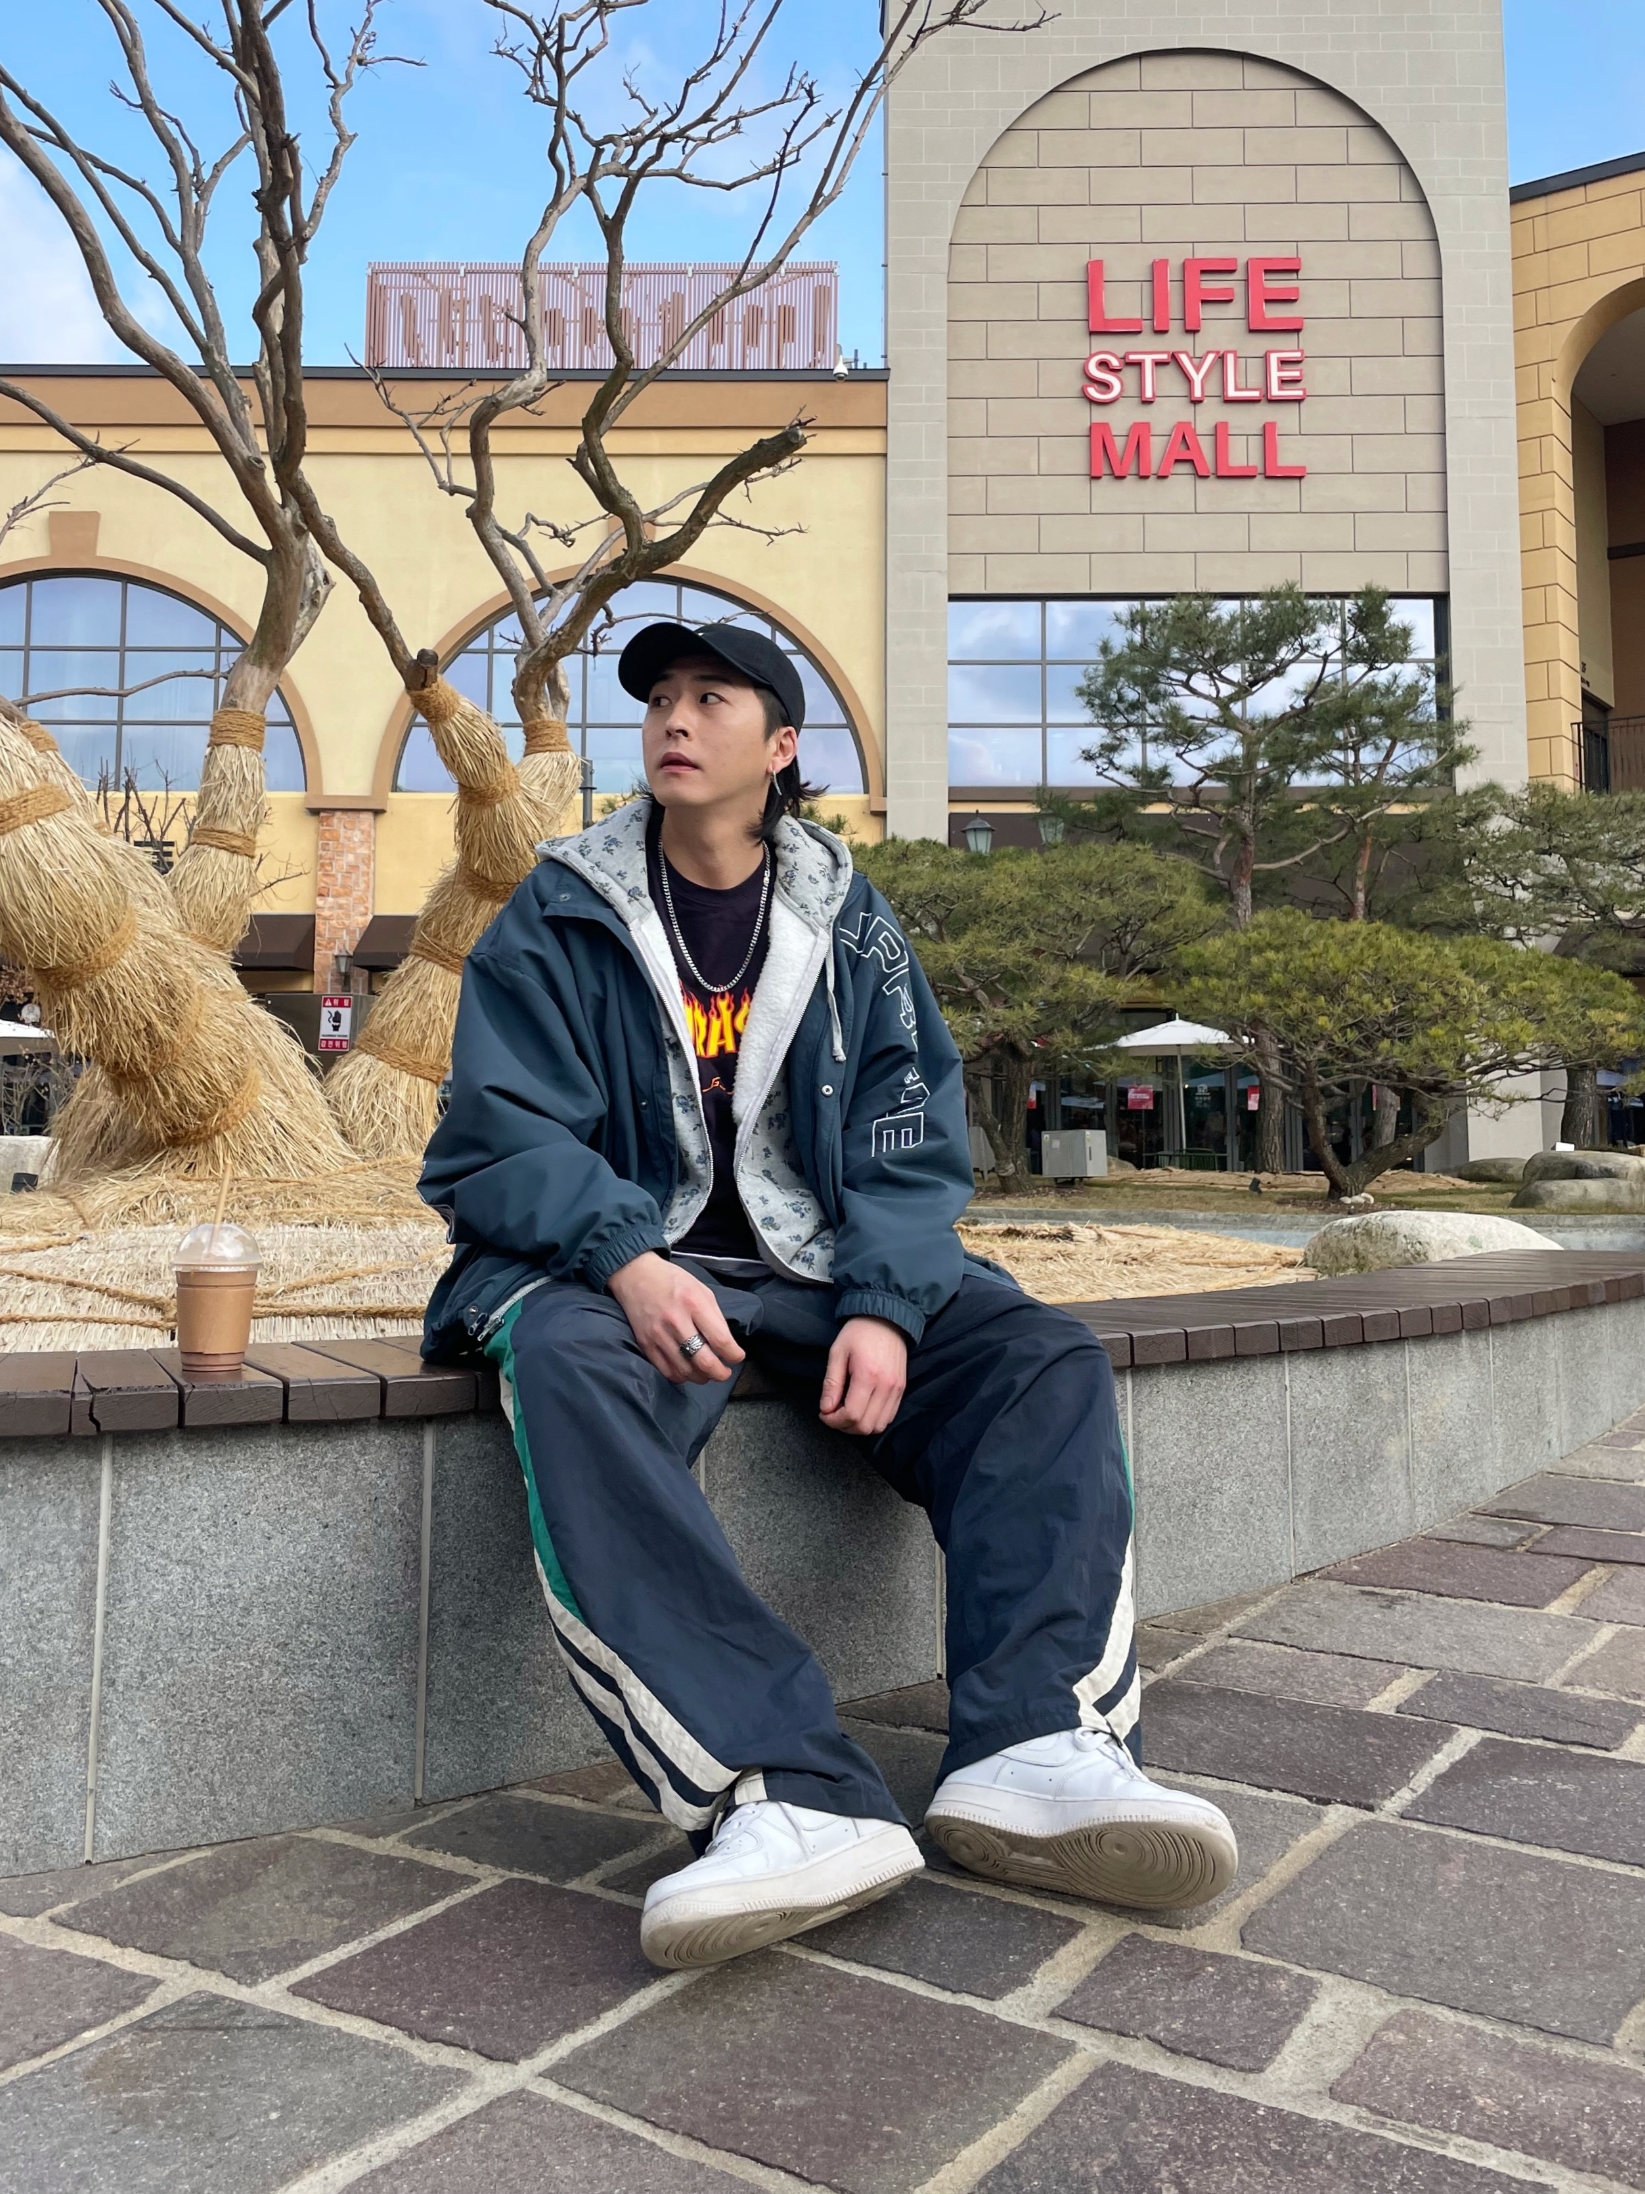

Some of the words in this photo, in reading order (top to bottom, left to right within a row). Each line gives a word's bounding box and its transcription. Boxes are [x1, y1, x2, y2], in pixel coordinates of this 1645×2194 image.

[1087, 257, 1304, 333] LIFE
[1082, 349, 1307, 403] STYLE
[1089, 421, 1307, 479] MALL
